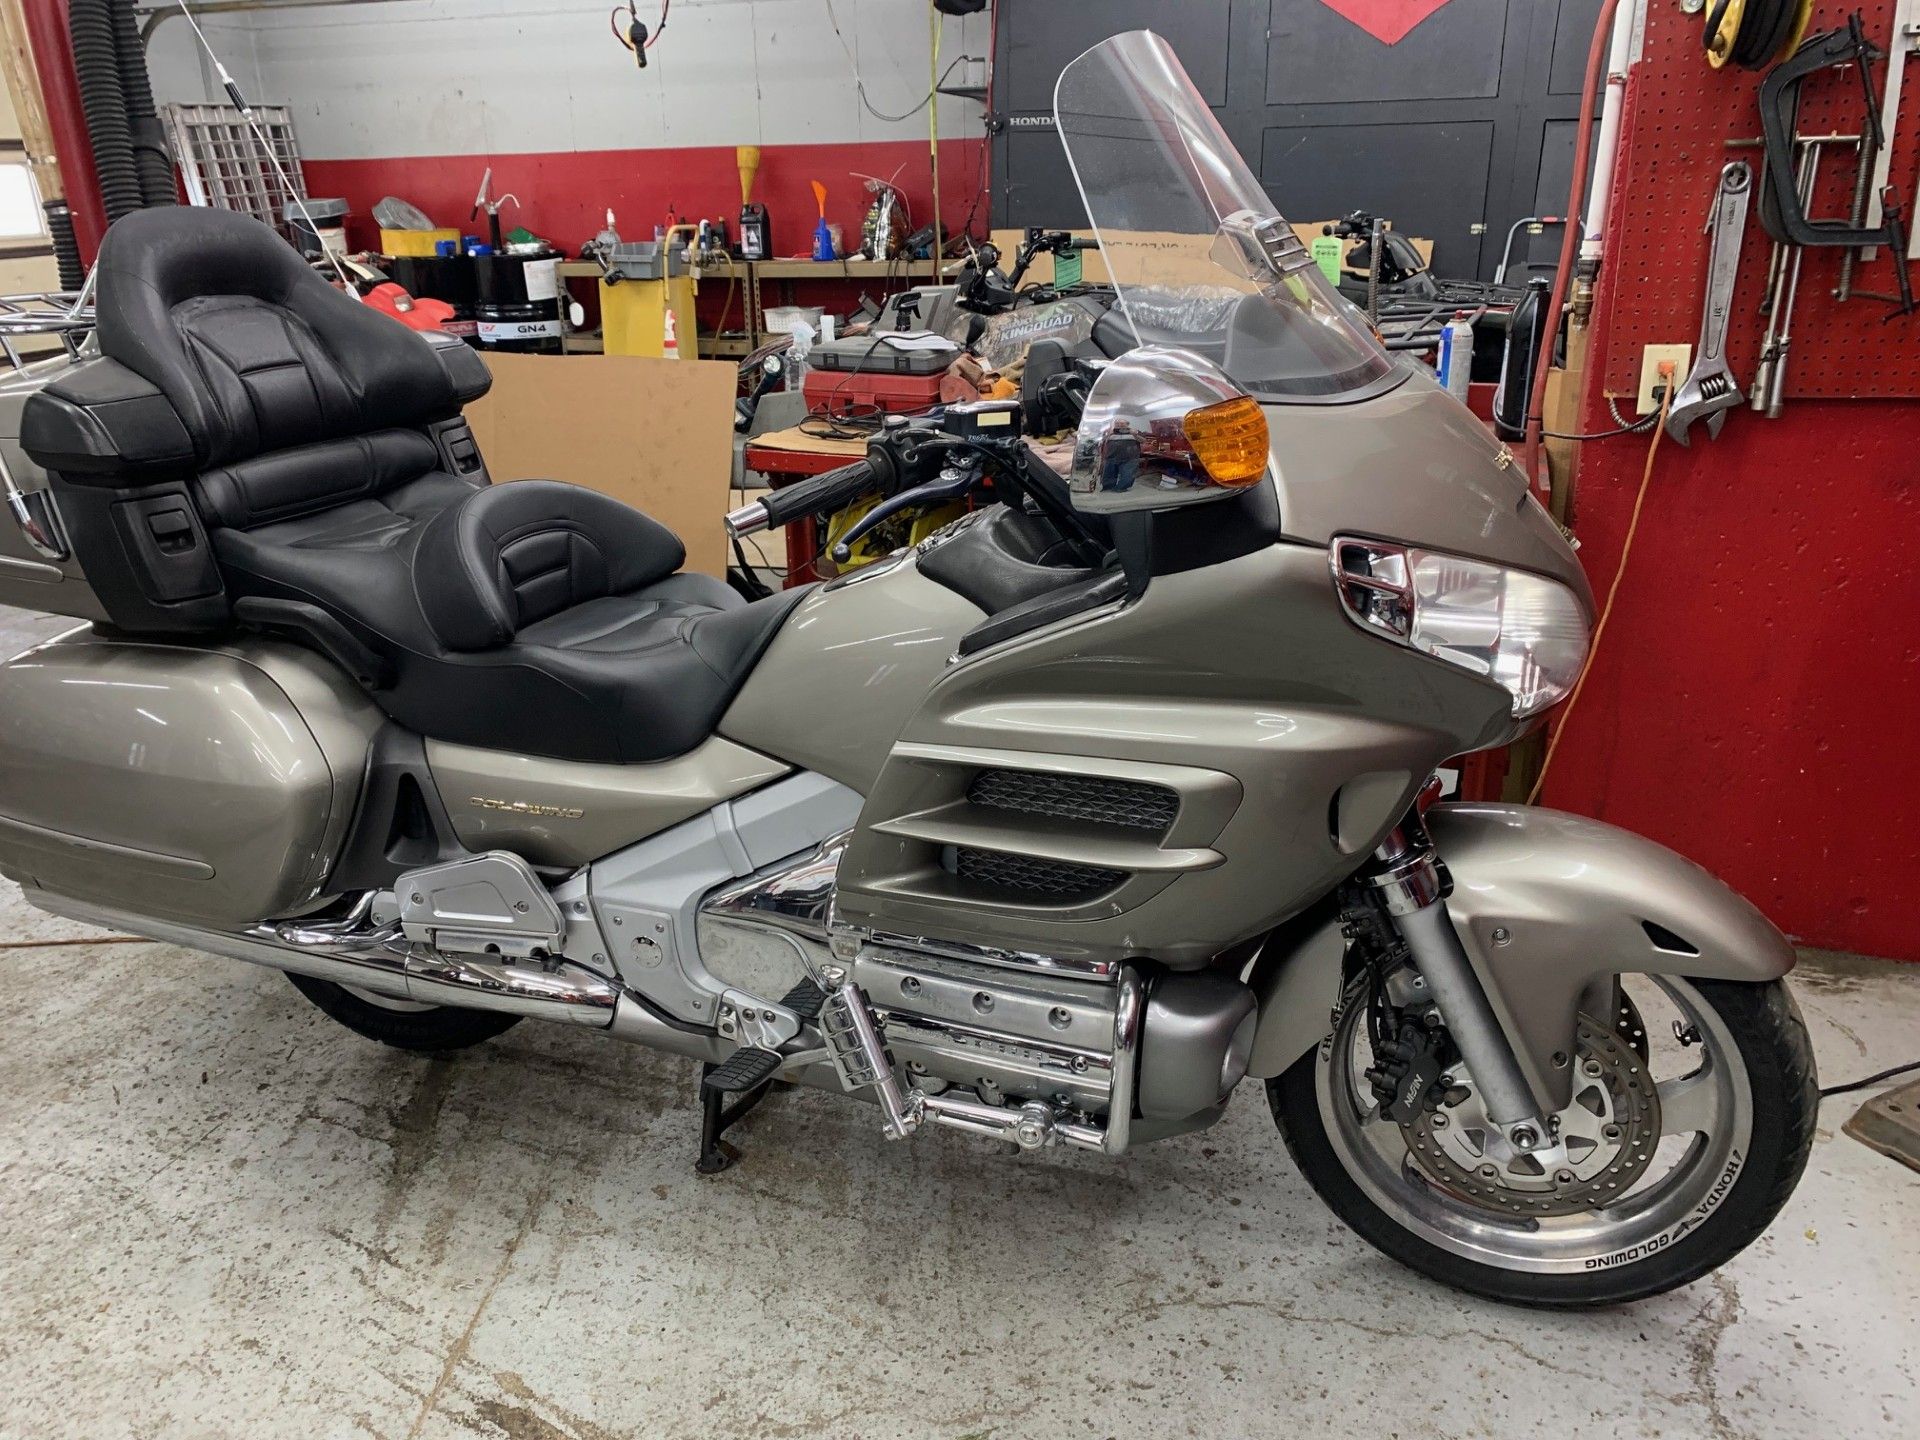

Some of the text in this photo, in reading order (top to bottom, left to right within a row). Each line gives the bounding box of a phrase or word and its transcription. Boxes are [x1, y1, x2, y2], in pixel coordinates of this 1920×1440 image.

[517, 324, 547, 334] GN4
[1695, 1160, 1740, 1219] HONDA
[1585, 1233, 1670, 1269] GOLDWING
